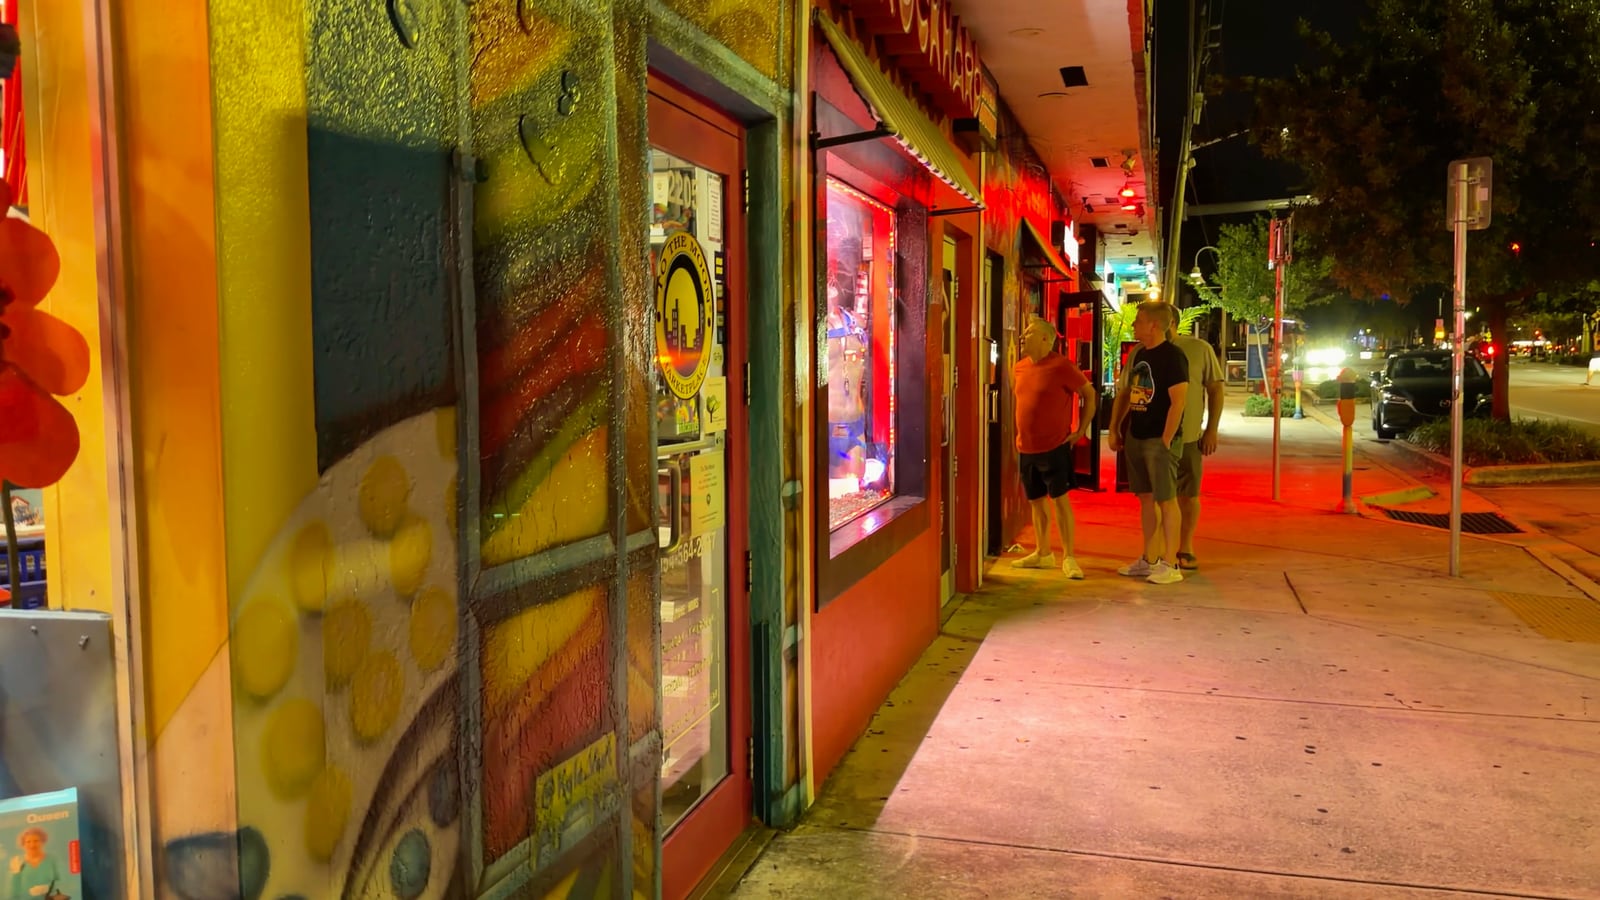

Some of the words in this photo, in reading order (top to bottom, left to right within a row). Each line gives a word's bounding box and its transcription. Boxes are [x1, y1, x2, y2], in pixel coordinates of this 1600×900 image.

[656, 258, 667, 289] TO
[667, 235, 687, 255] THE
[690, 241, 710, 303] MOON
[27, 811, 69, 823] Queen
